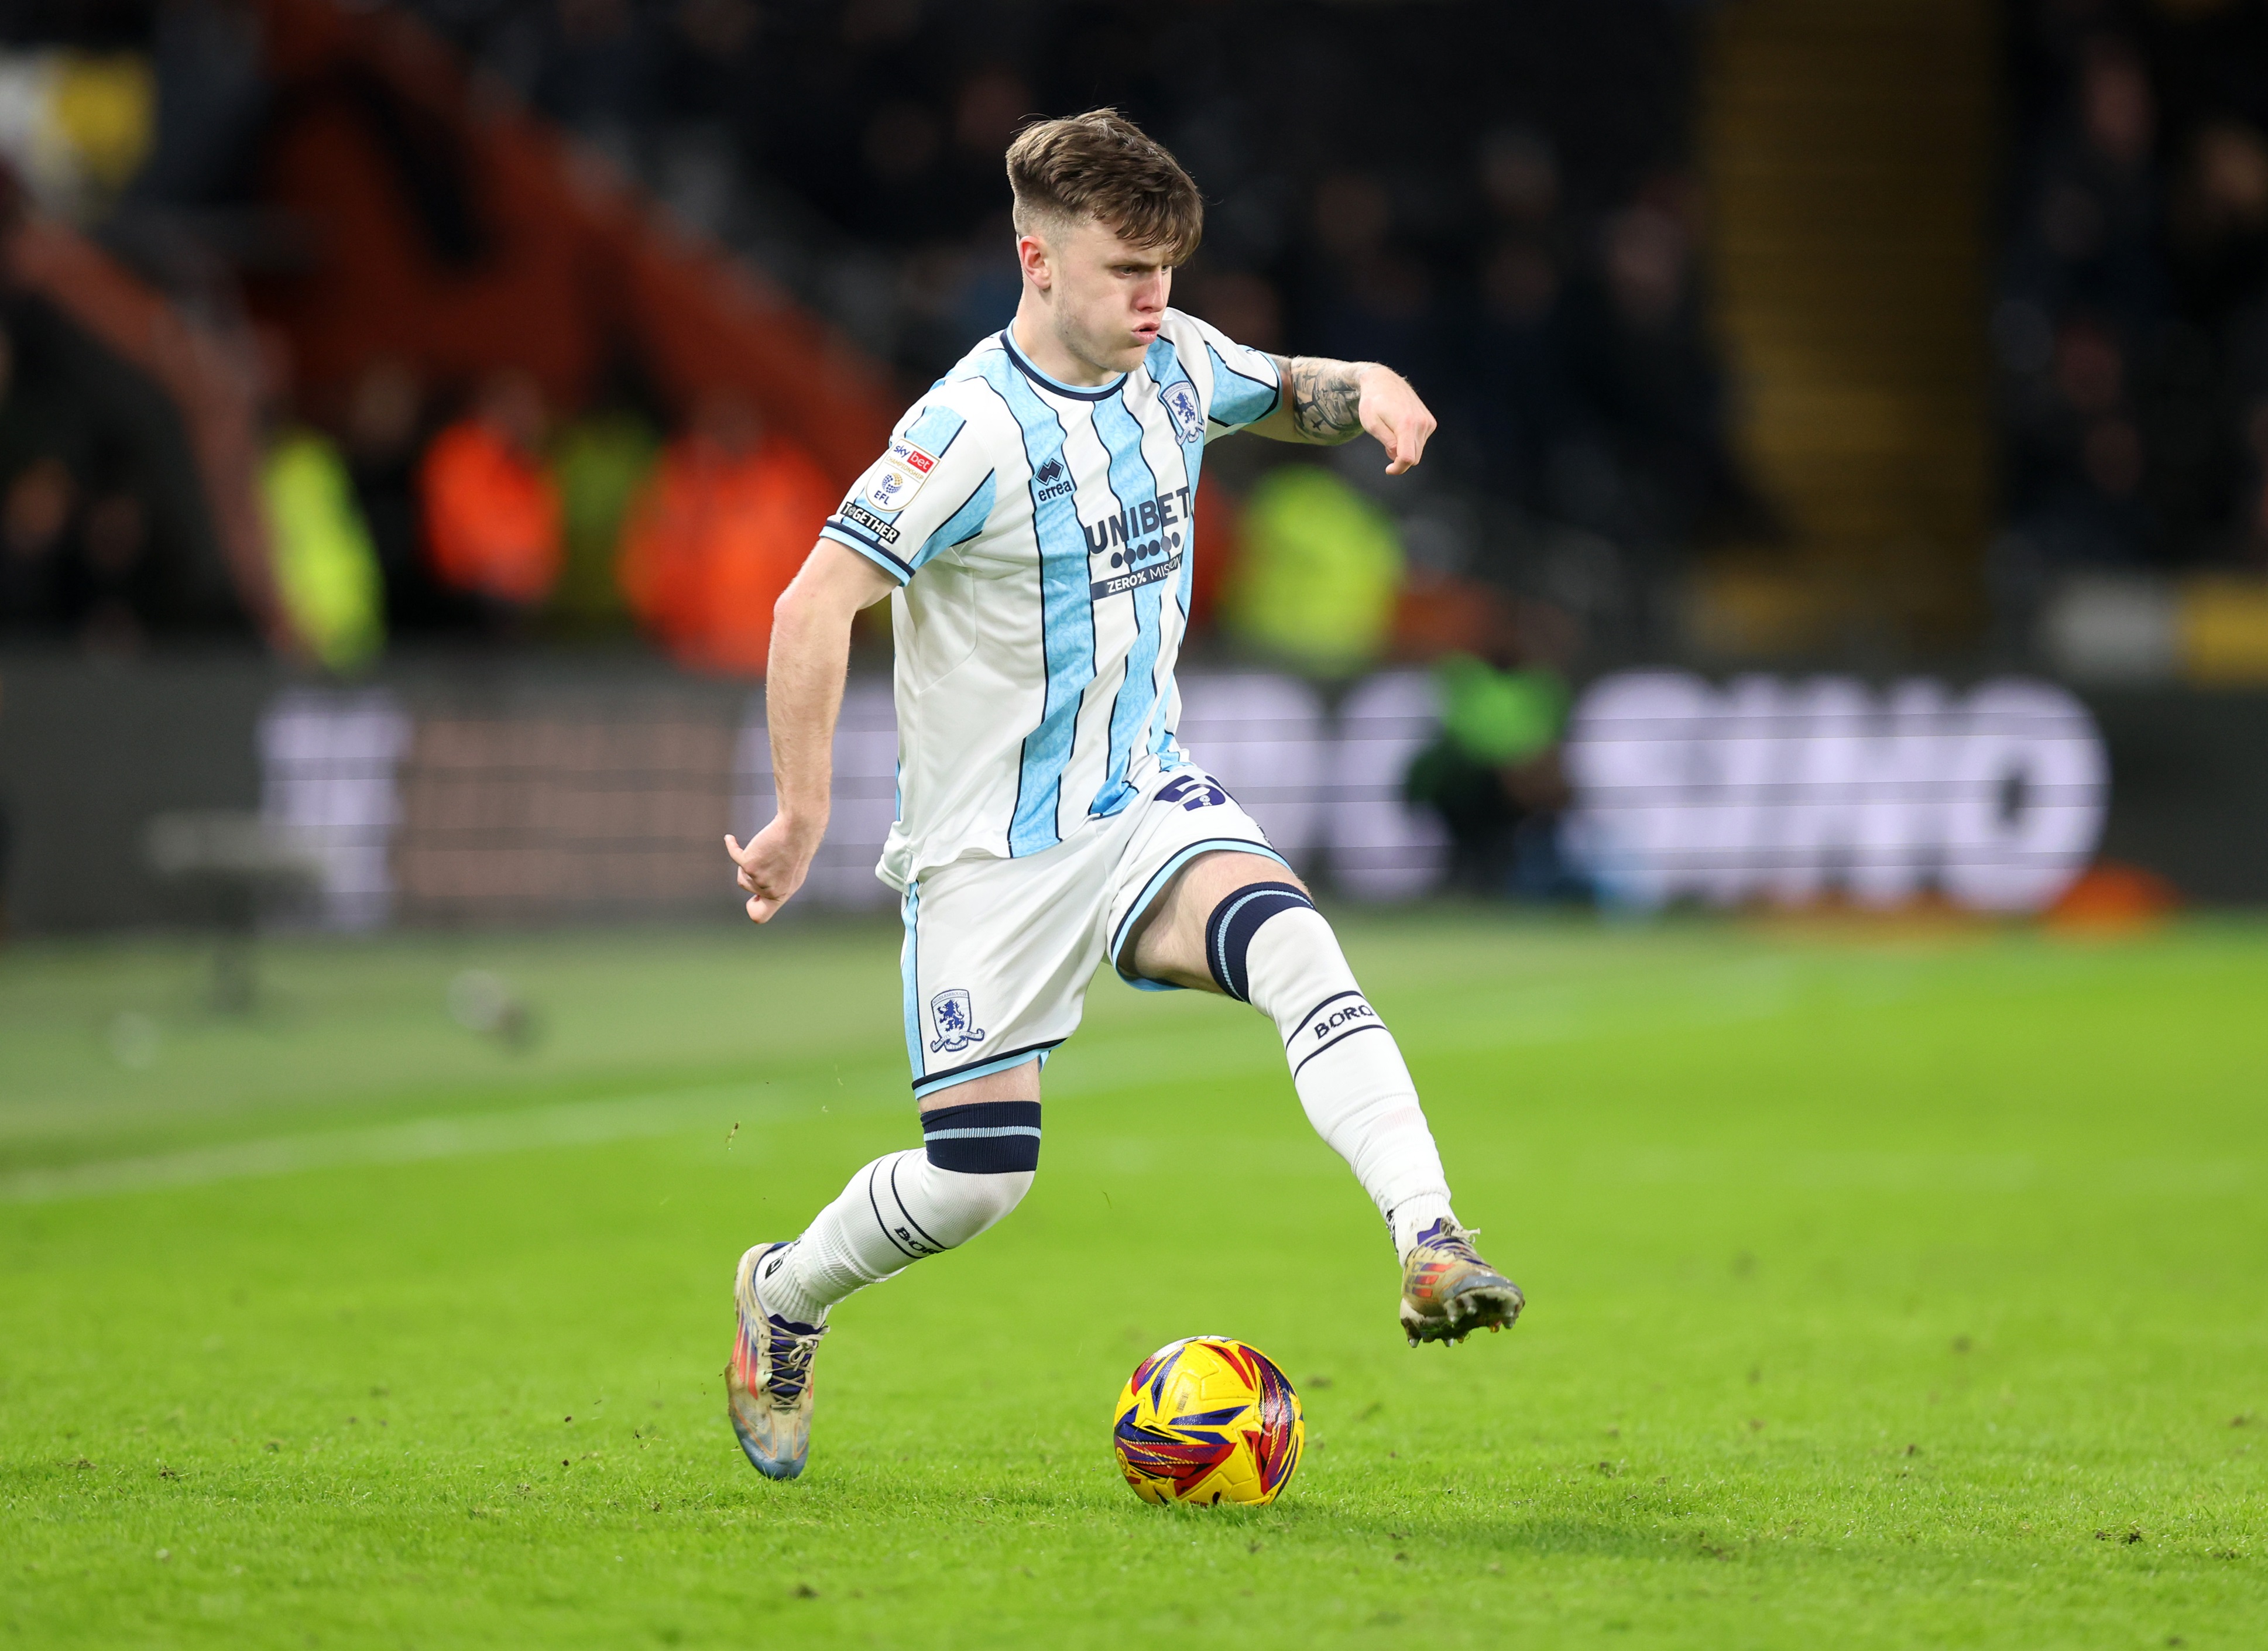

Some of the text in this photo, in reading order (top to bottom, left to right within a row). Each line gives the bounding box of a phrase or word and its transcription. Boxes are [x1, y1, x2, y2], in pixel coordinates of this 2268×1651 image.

[886, 456, 924, 480] CHAMPIONSHIP
[893, 445, 930, 470] sky bet
[874, 490, 890, 504] EFL
[1038, 480, 1072, 502] errea
[1085, 486, 1189, 554] UNIBET
[1106, 571, 1147, 593] ZERO%
